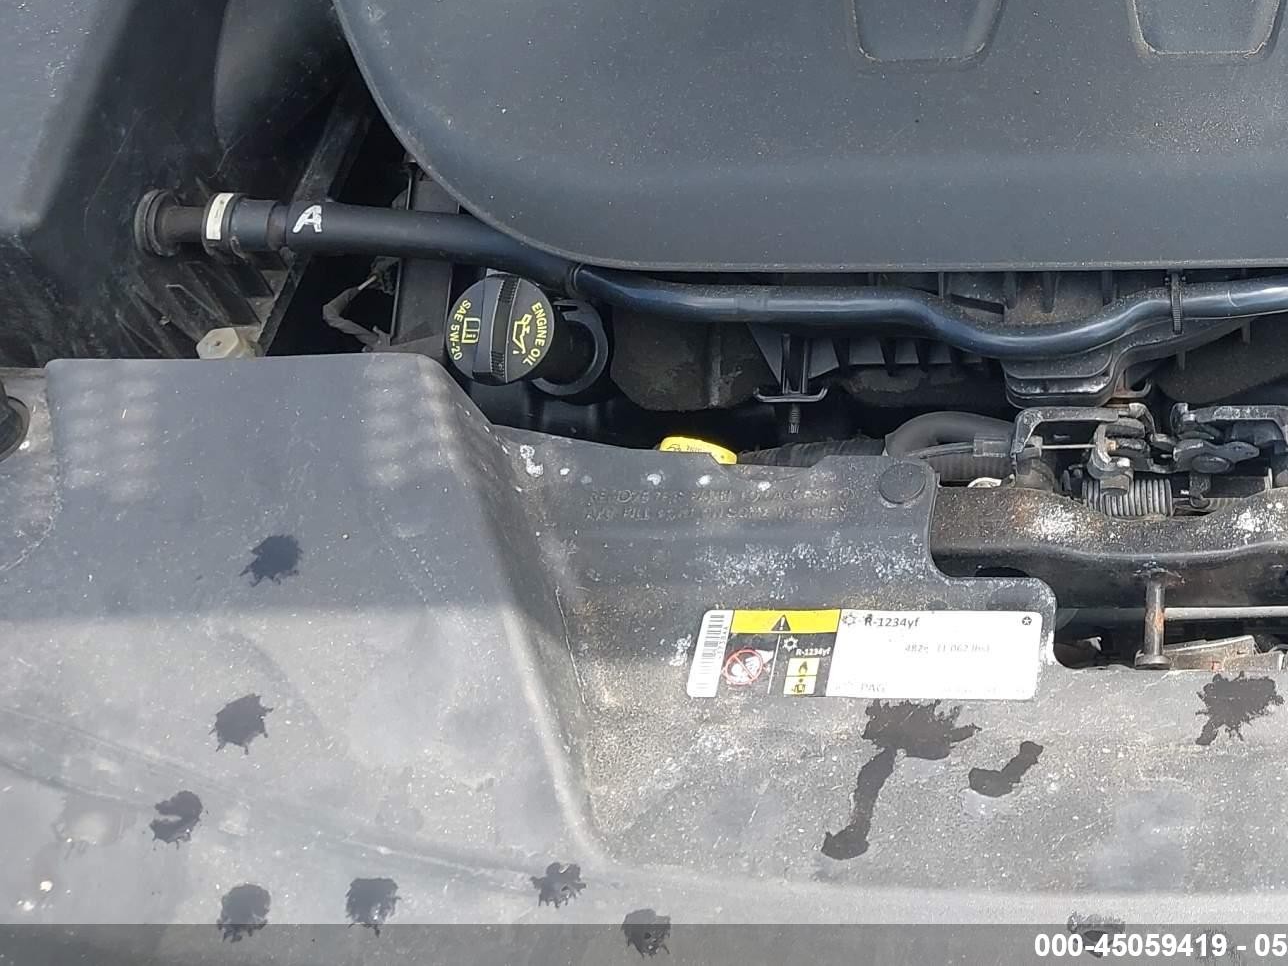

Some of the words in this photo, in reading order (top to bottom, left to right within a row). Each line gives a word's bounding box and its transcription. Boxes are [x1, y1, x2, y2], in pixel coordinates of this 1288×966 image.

[293, 204, 322, 233] A
[453, 299, 472, 322] SAE
[531, 301, 548, 347] ENGINE
[449, 323, 463, 361] 5W-20
[522, 347, 541, 366] OIL
[863, 615, 920, 630] R-1234yf
[795, 646, 832, 657] R-1234yf
